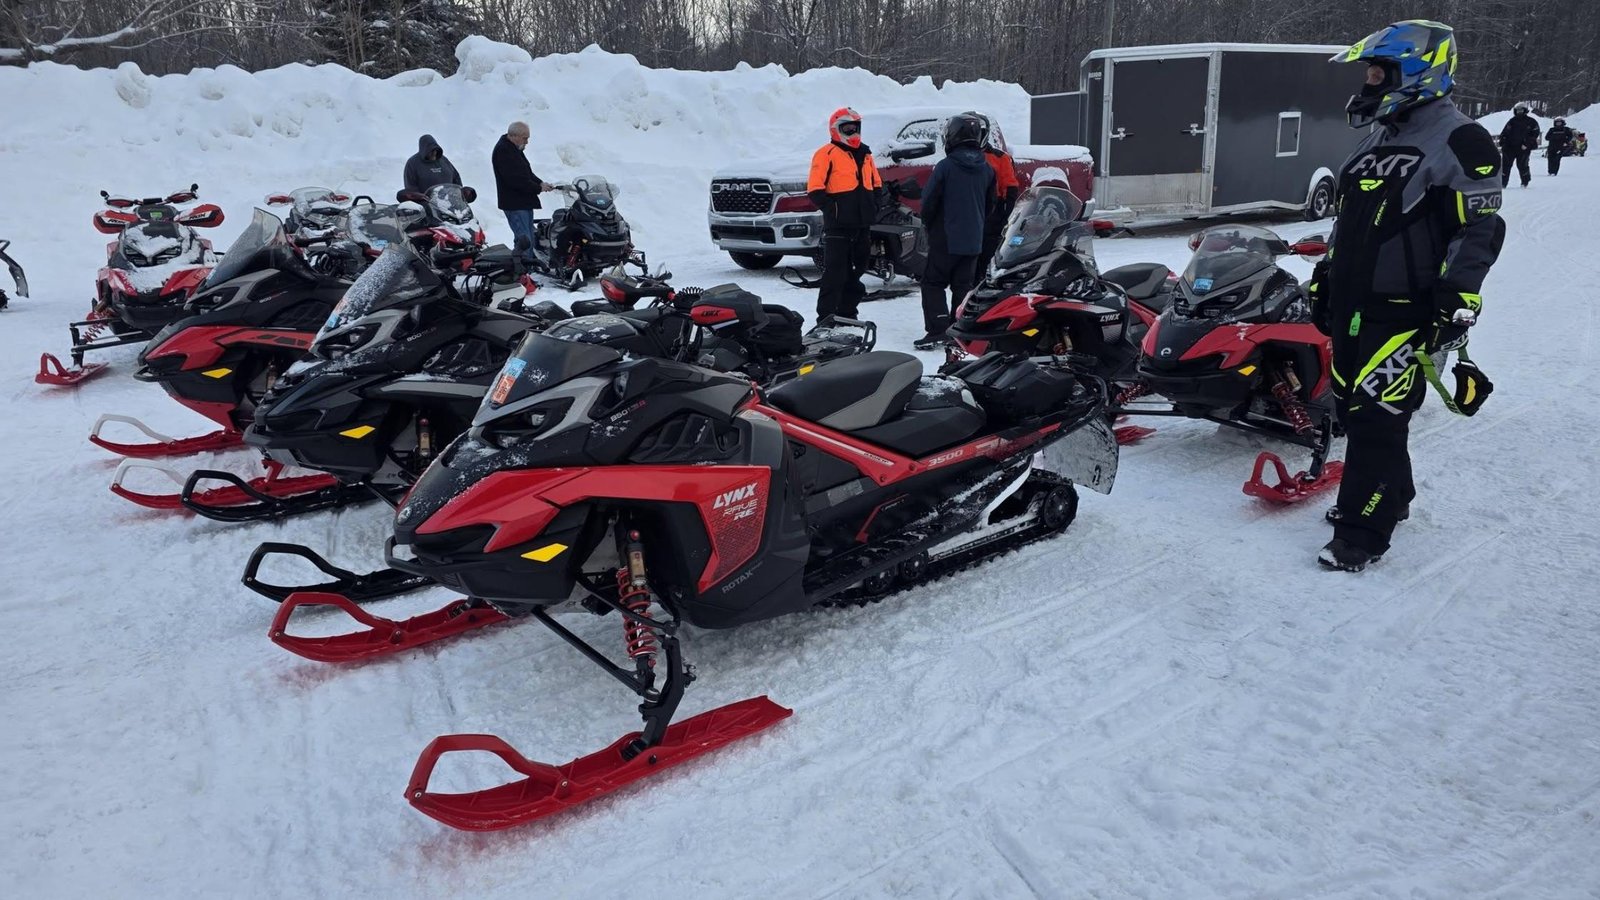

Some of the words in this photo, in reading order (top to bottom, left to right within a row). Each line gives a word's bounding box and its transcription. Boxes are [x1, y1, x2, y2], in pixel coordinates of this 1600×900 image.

[1348, 153, 1420, 178] FXR
[720, 183, 752, 191] RAM
[1467, 194, 1502, 210] FXR
[1100, 312, 1121, 322] LYNX
[1361, 343, 1416, 398] FXR
[928, 449, 964, 467] 3500
[712, 482, 758, 510] LYNX
[1361, 492, 1383, 517] TEAM
[721, 569, 754, 594] ROTAX
